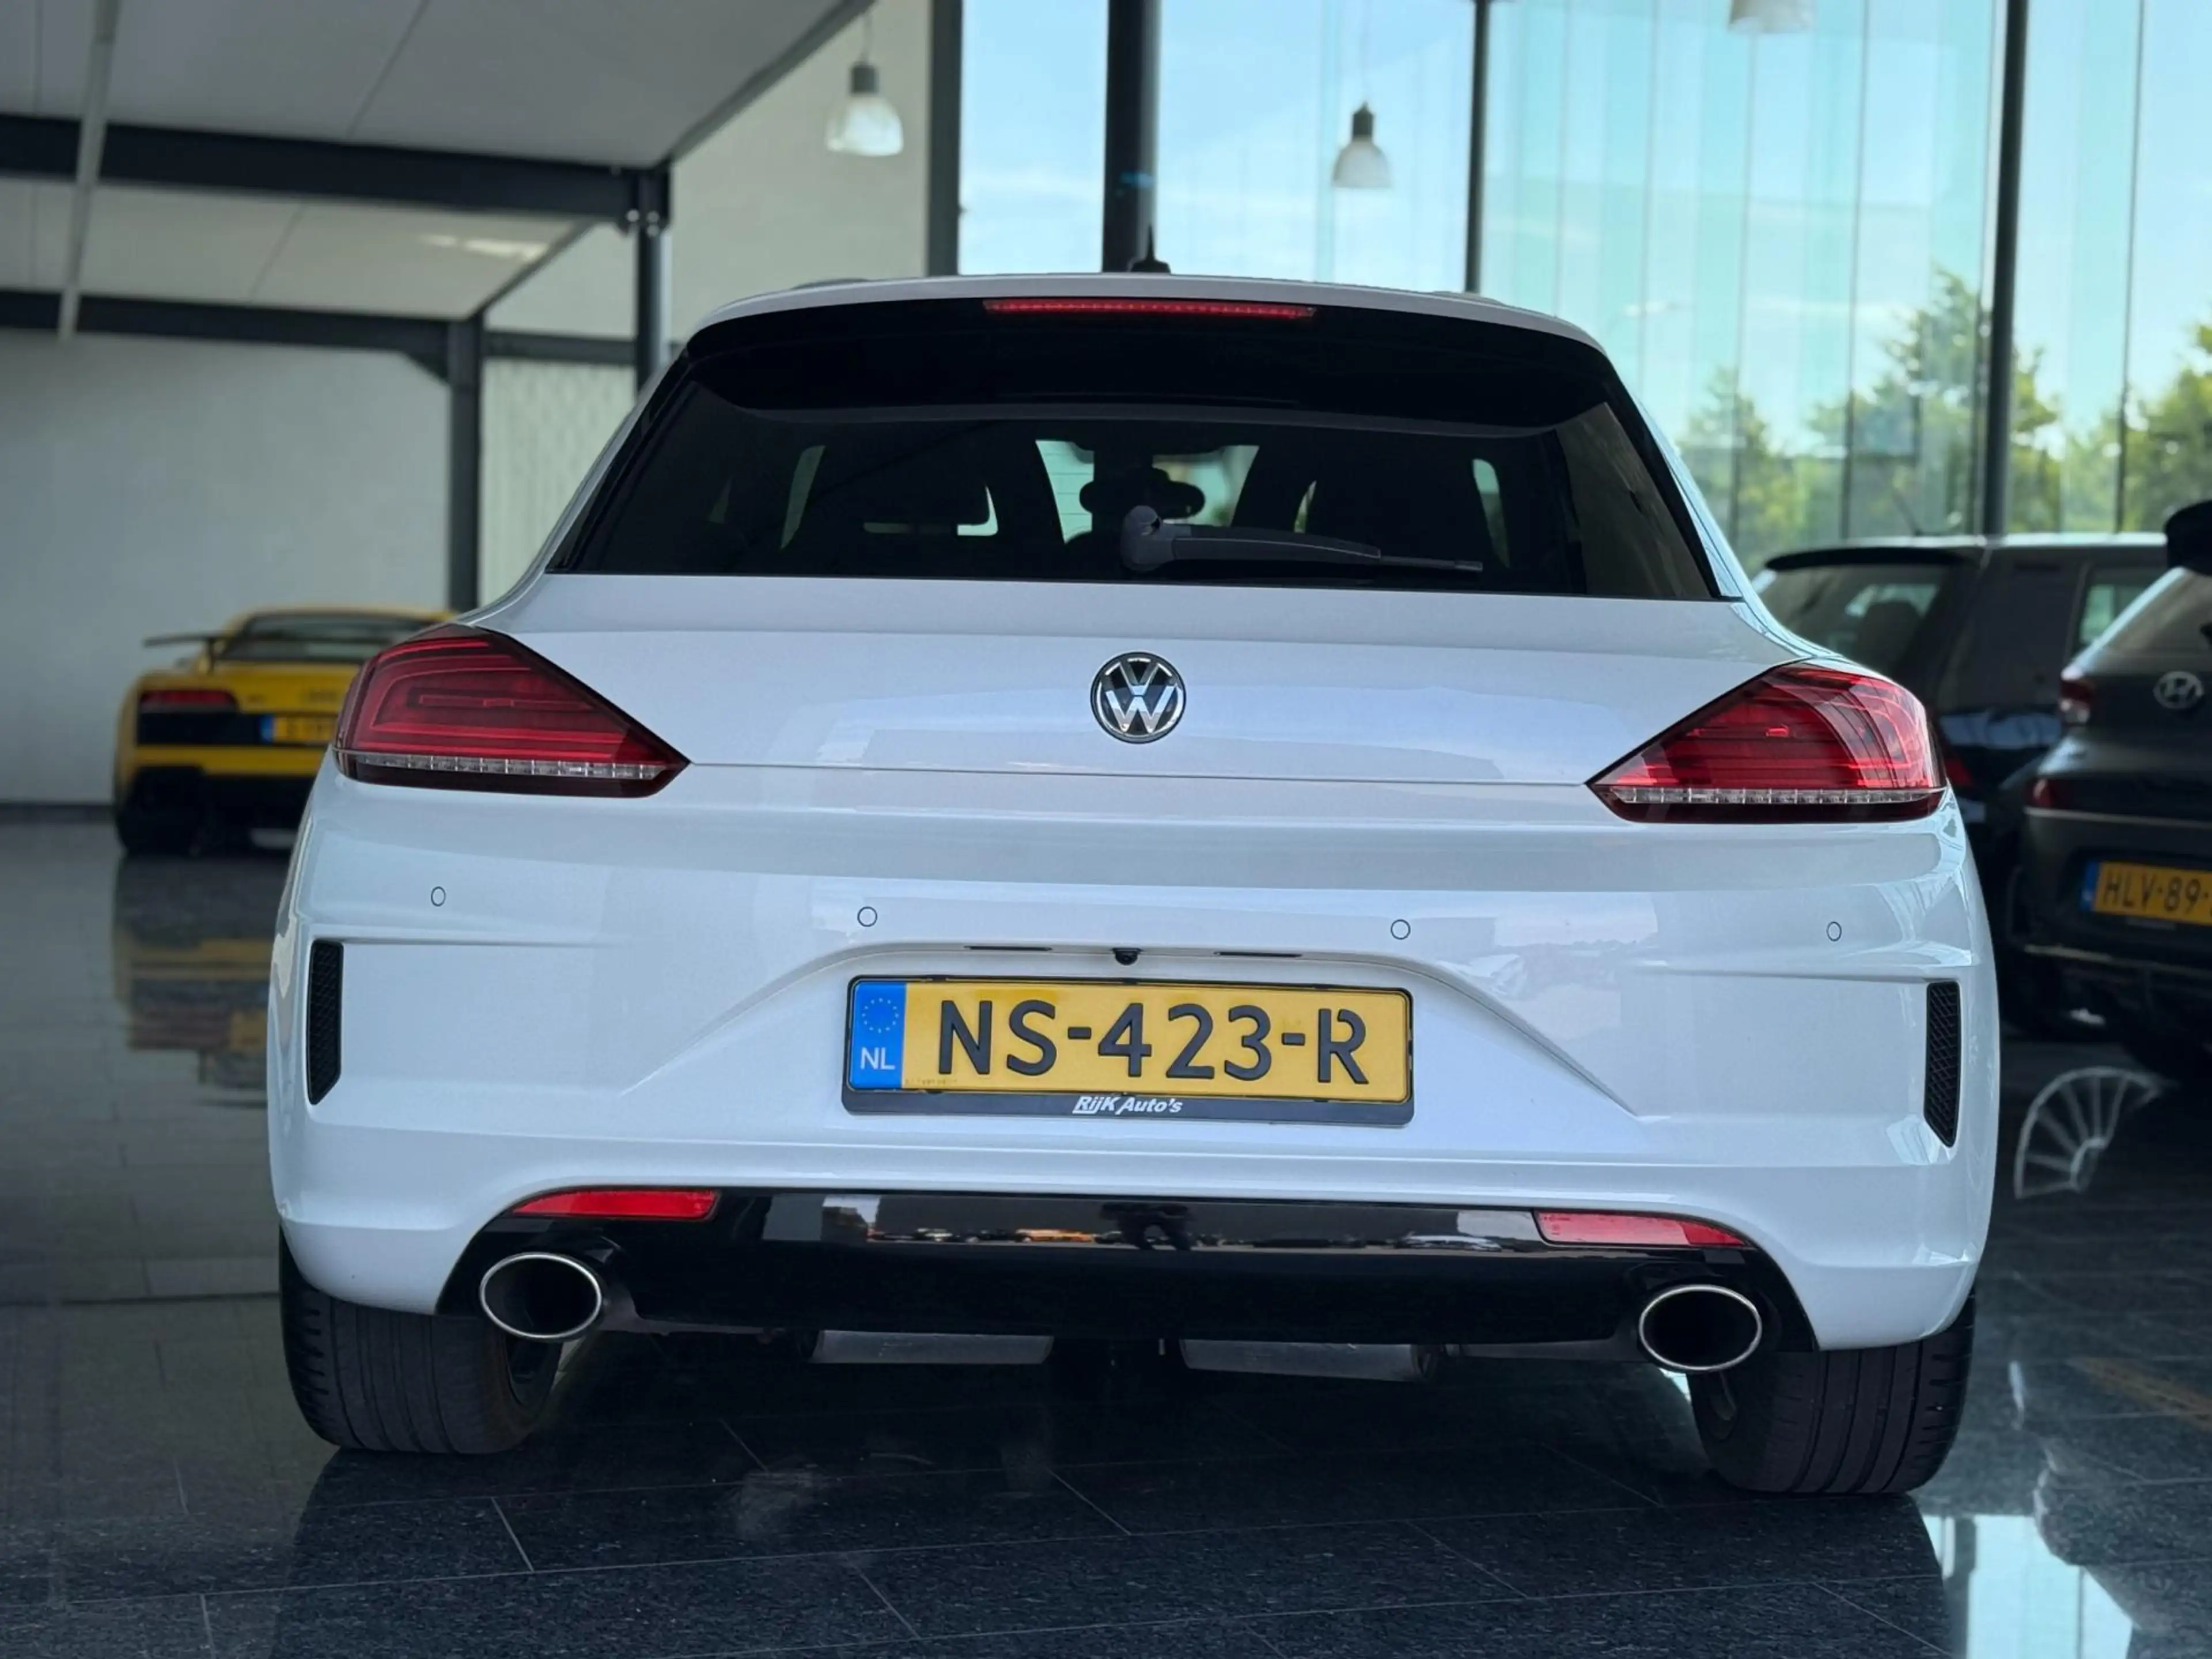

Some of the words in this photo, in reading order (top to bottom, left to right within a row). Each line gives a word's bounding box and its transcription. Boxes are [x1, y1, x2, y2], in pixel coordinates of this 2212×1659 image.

[1096, 656, 1181, 737] VW
[2103, 869, 2212, 919] HLV-89-
[860, 1047, 895, 1070] NL
[939, 1000, 1369, 1084] NS-423-R
[1115, 1097, 1183, 1115] Auto's
